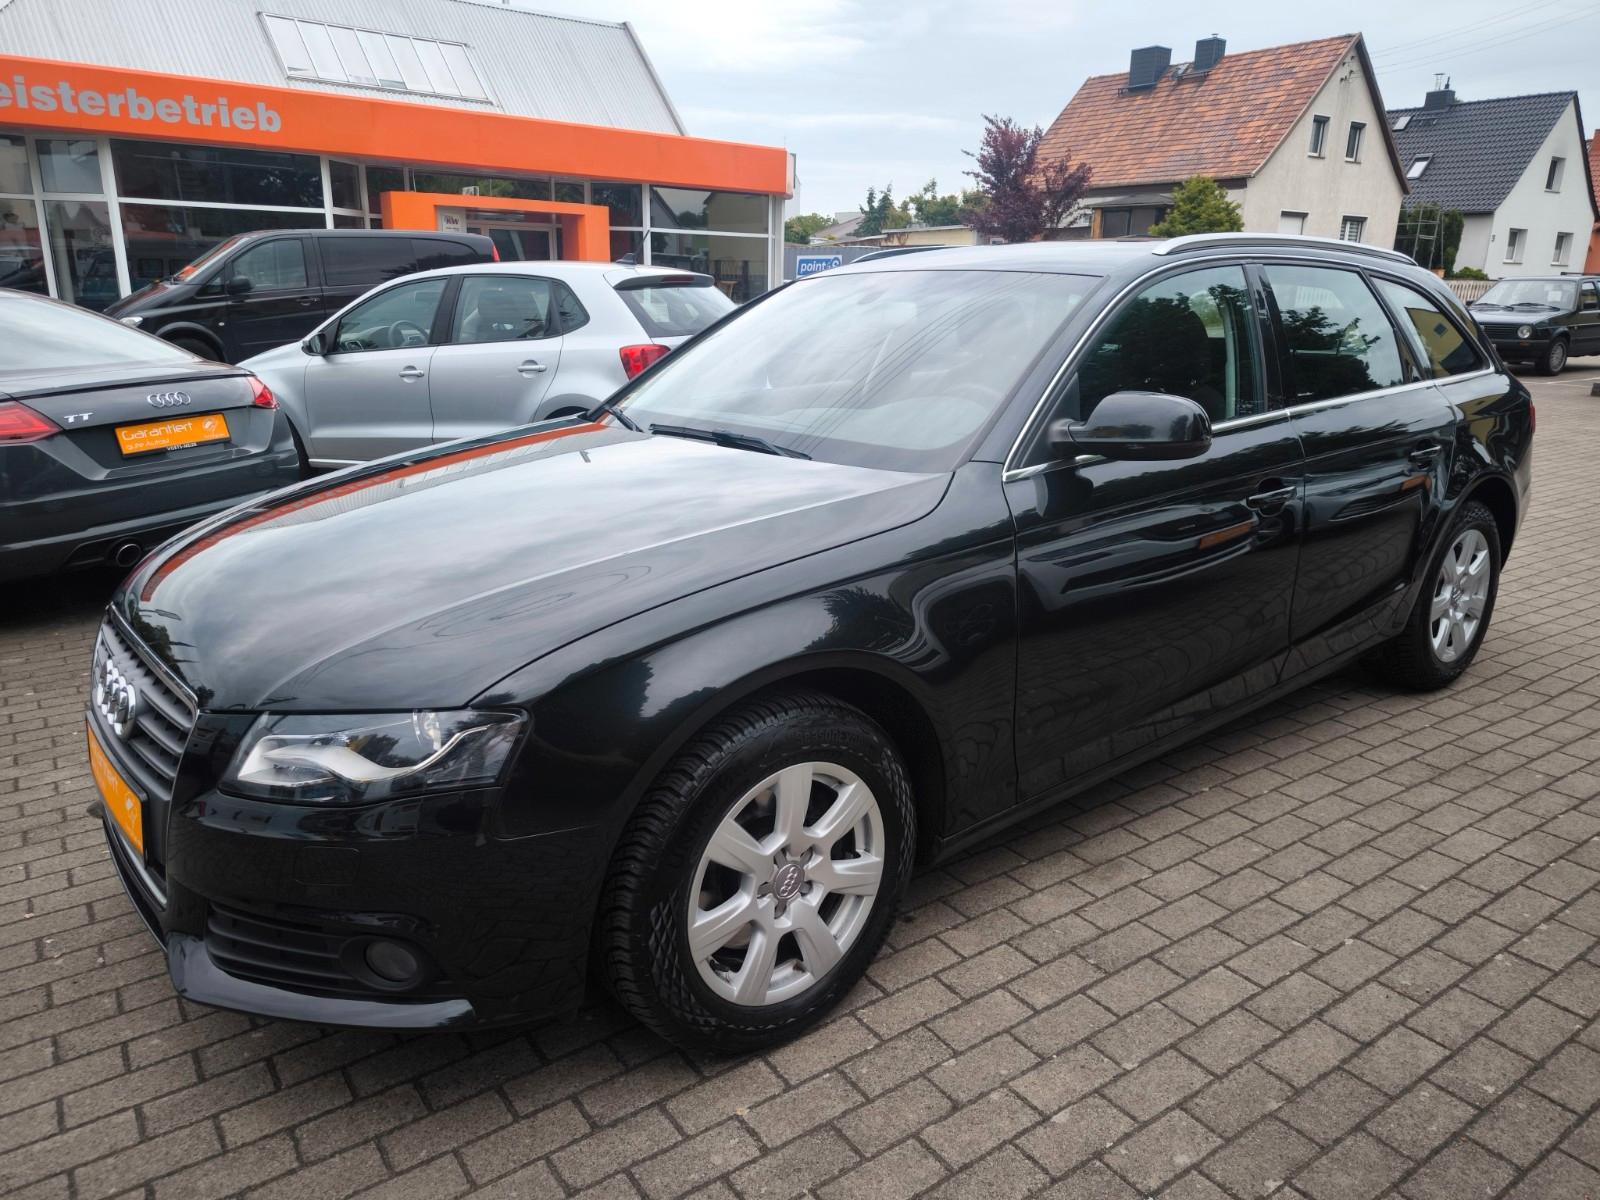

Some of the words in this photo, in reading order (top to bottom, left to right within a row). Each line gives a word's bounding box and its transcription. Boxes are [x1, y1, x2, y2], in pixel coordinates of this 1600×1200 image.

[800, 261, 827, 274] point
[64, 412, 94, 423] TT
[121, 422, 193, 441] Garantiert
